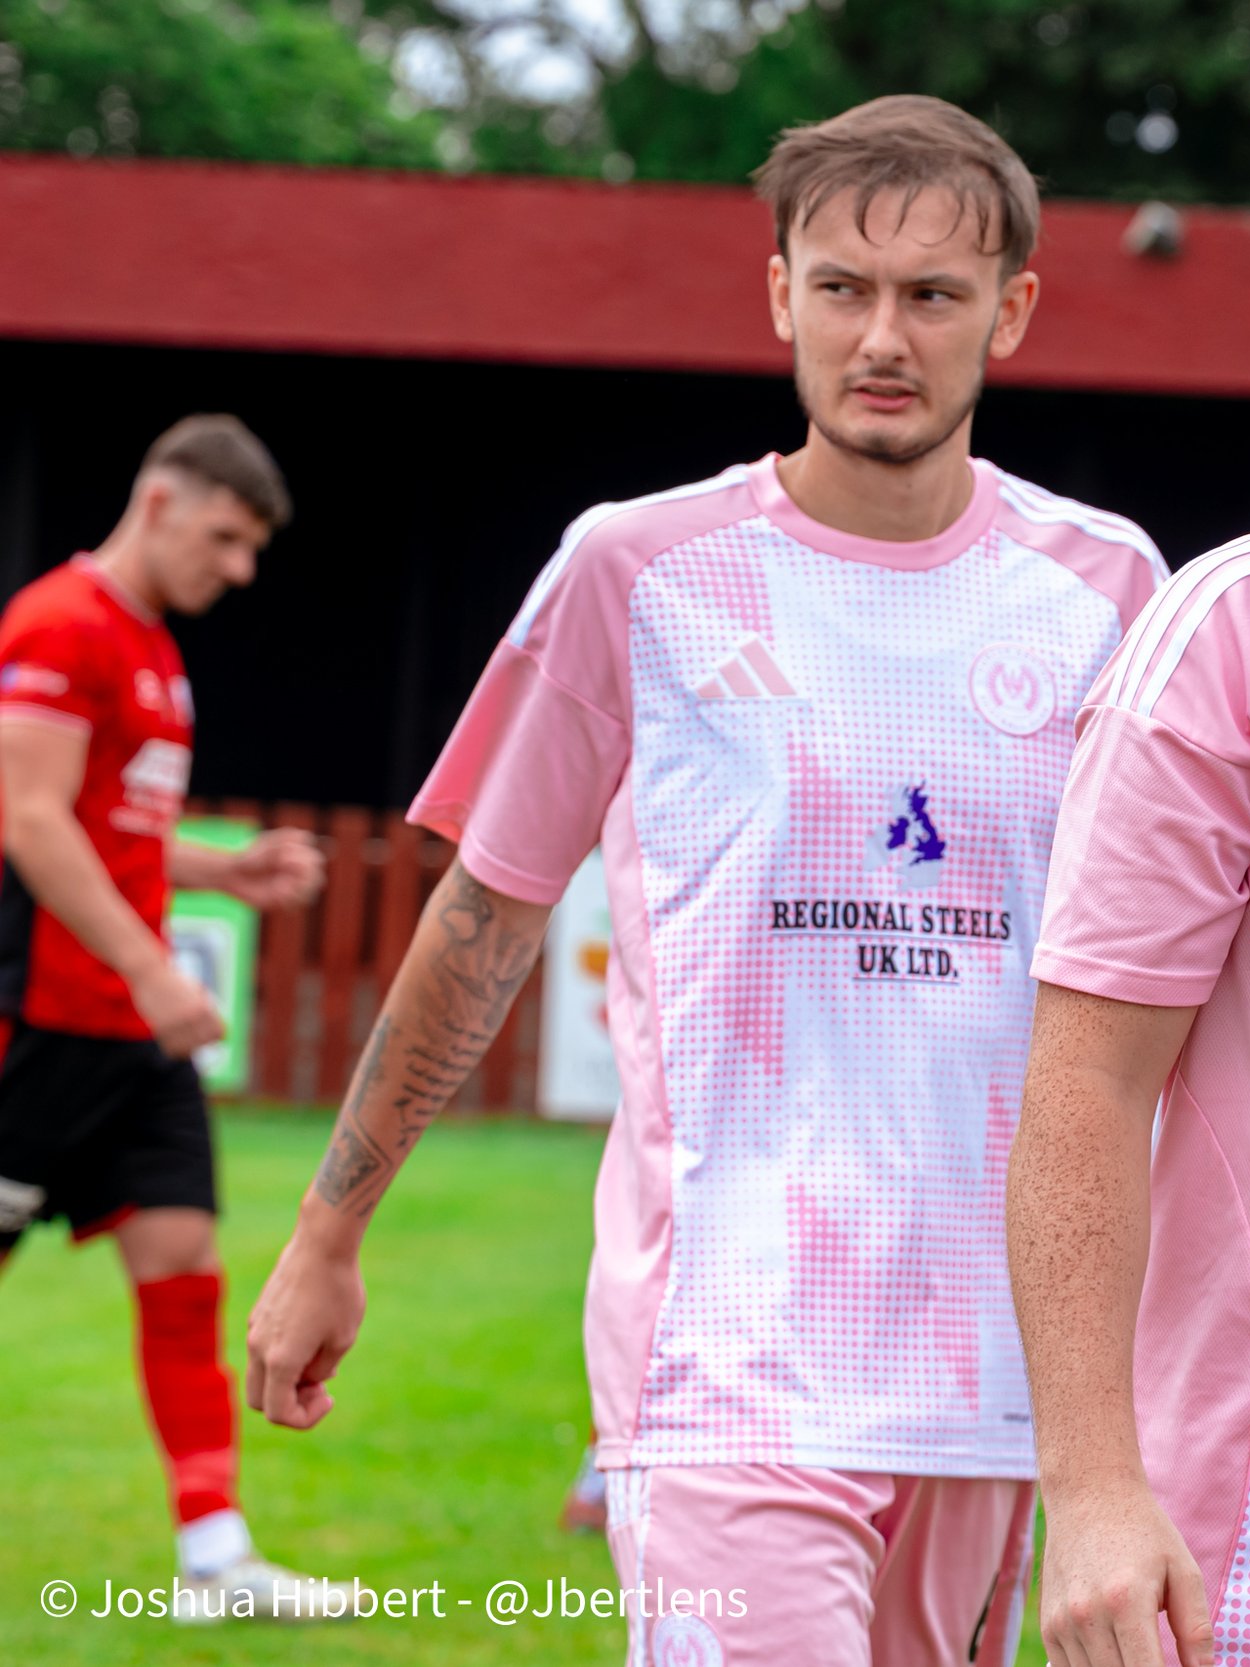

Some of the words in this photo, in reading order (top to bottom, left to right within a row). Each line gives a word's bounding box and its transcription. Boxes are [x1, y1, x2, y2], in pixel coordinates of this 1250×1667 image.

[772, 900, 912, 931] REGIONAL
[921, 906, 1011, 940] STEELS
[858, 945, 898, 974] UK
[908, 947, 958, 977] LTD.
